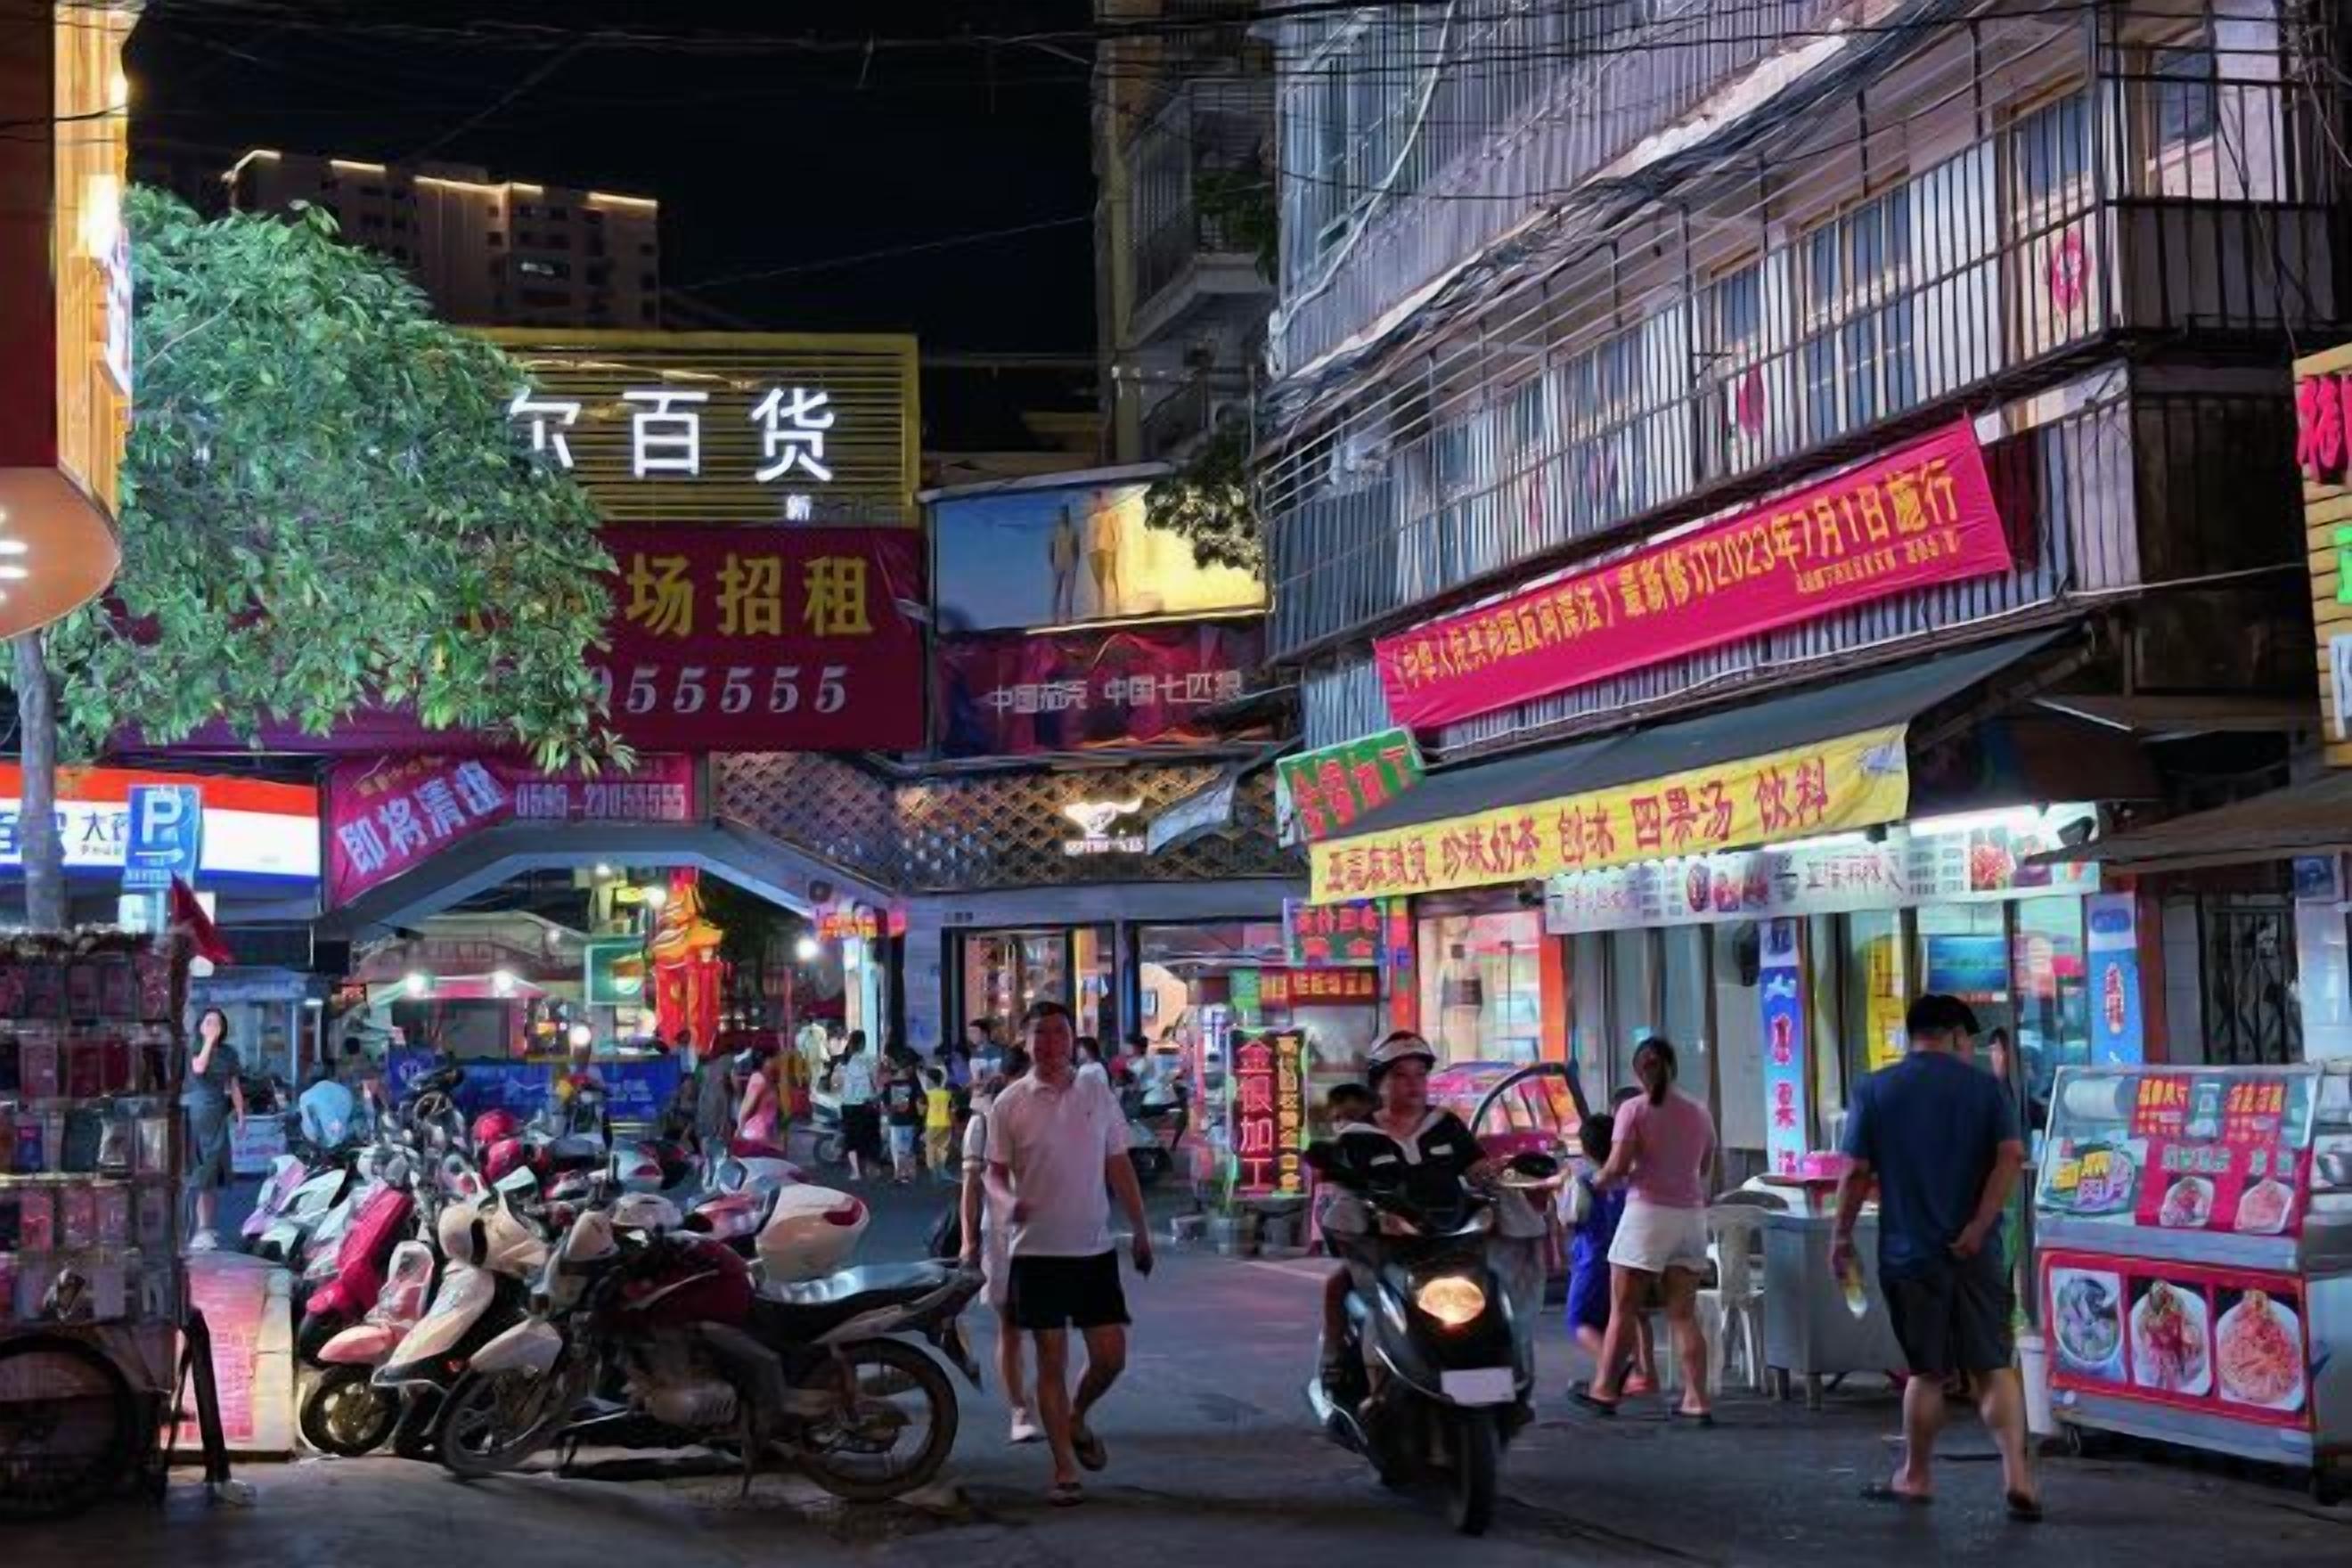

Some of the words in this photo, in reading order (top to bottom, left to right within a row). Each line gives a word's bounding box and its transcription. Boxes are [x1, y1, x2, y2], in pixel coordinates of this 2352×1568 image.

[142, 790, 184, 844] P
[1629, 779, 1734, 850] 四果汤
[1753, 755, 1829, 836] 饮料
